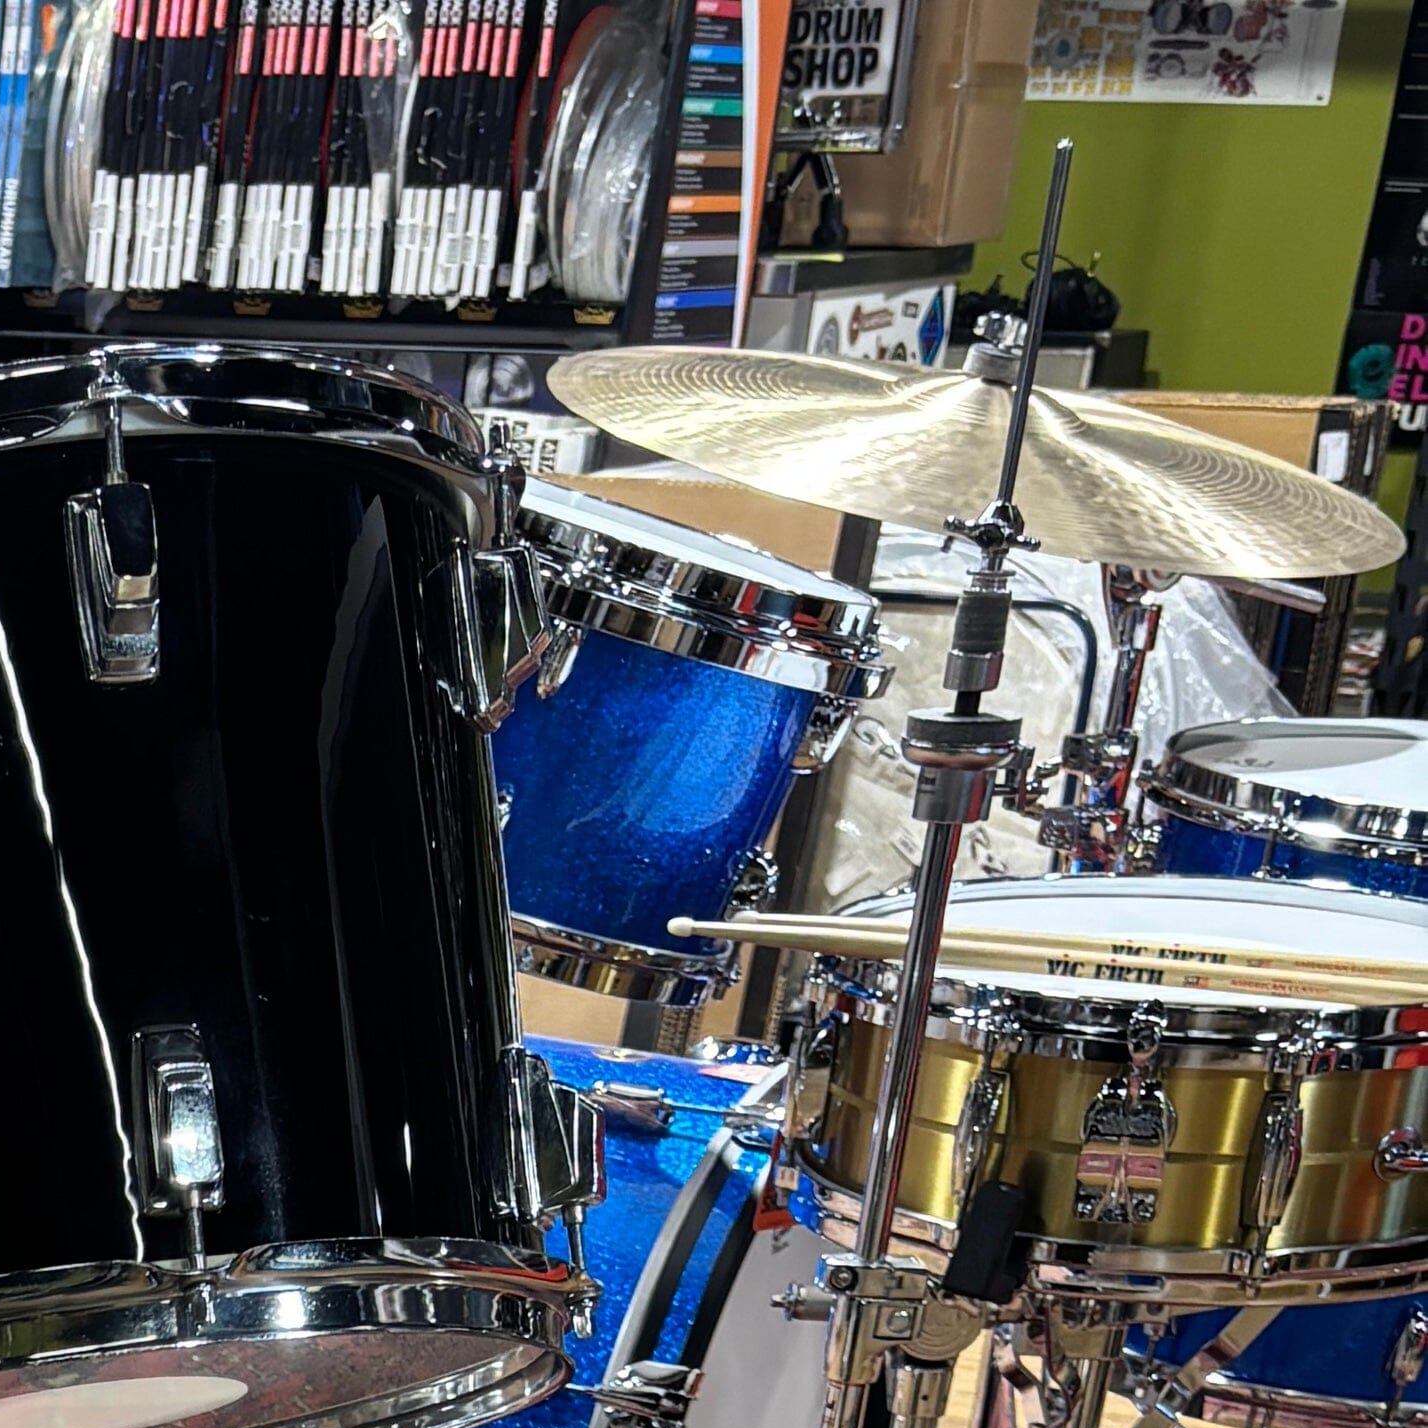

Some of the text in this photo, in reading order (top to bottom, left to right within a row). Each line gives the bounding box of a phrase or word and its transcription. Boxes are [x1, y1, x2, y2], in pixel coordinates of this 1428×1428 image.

[791, 8, 884, 44] DRUM
[782, 47, 879, 89] SHOP
[1046, 953, 1165, 985] VIC FIRTH
